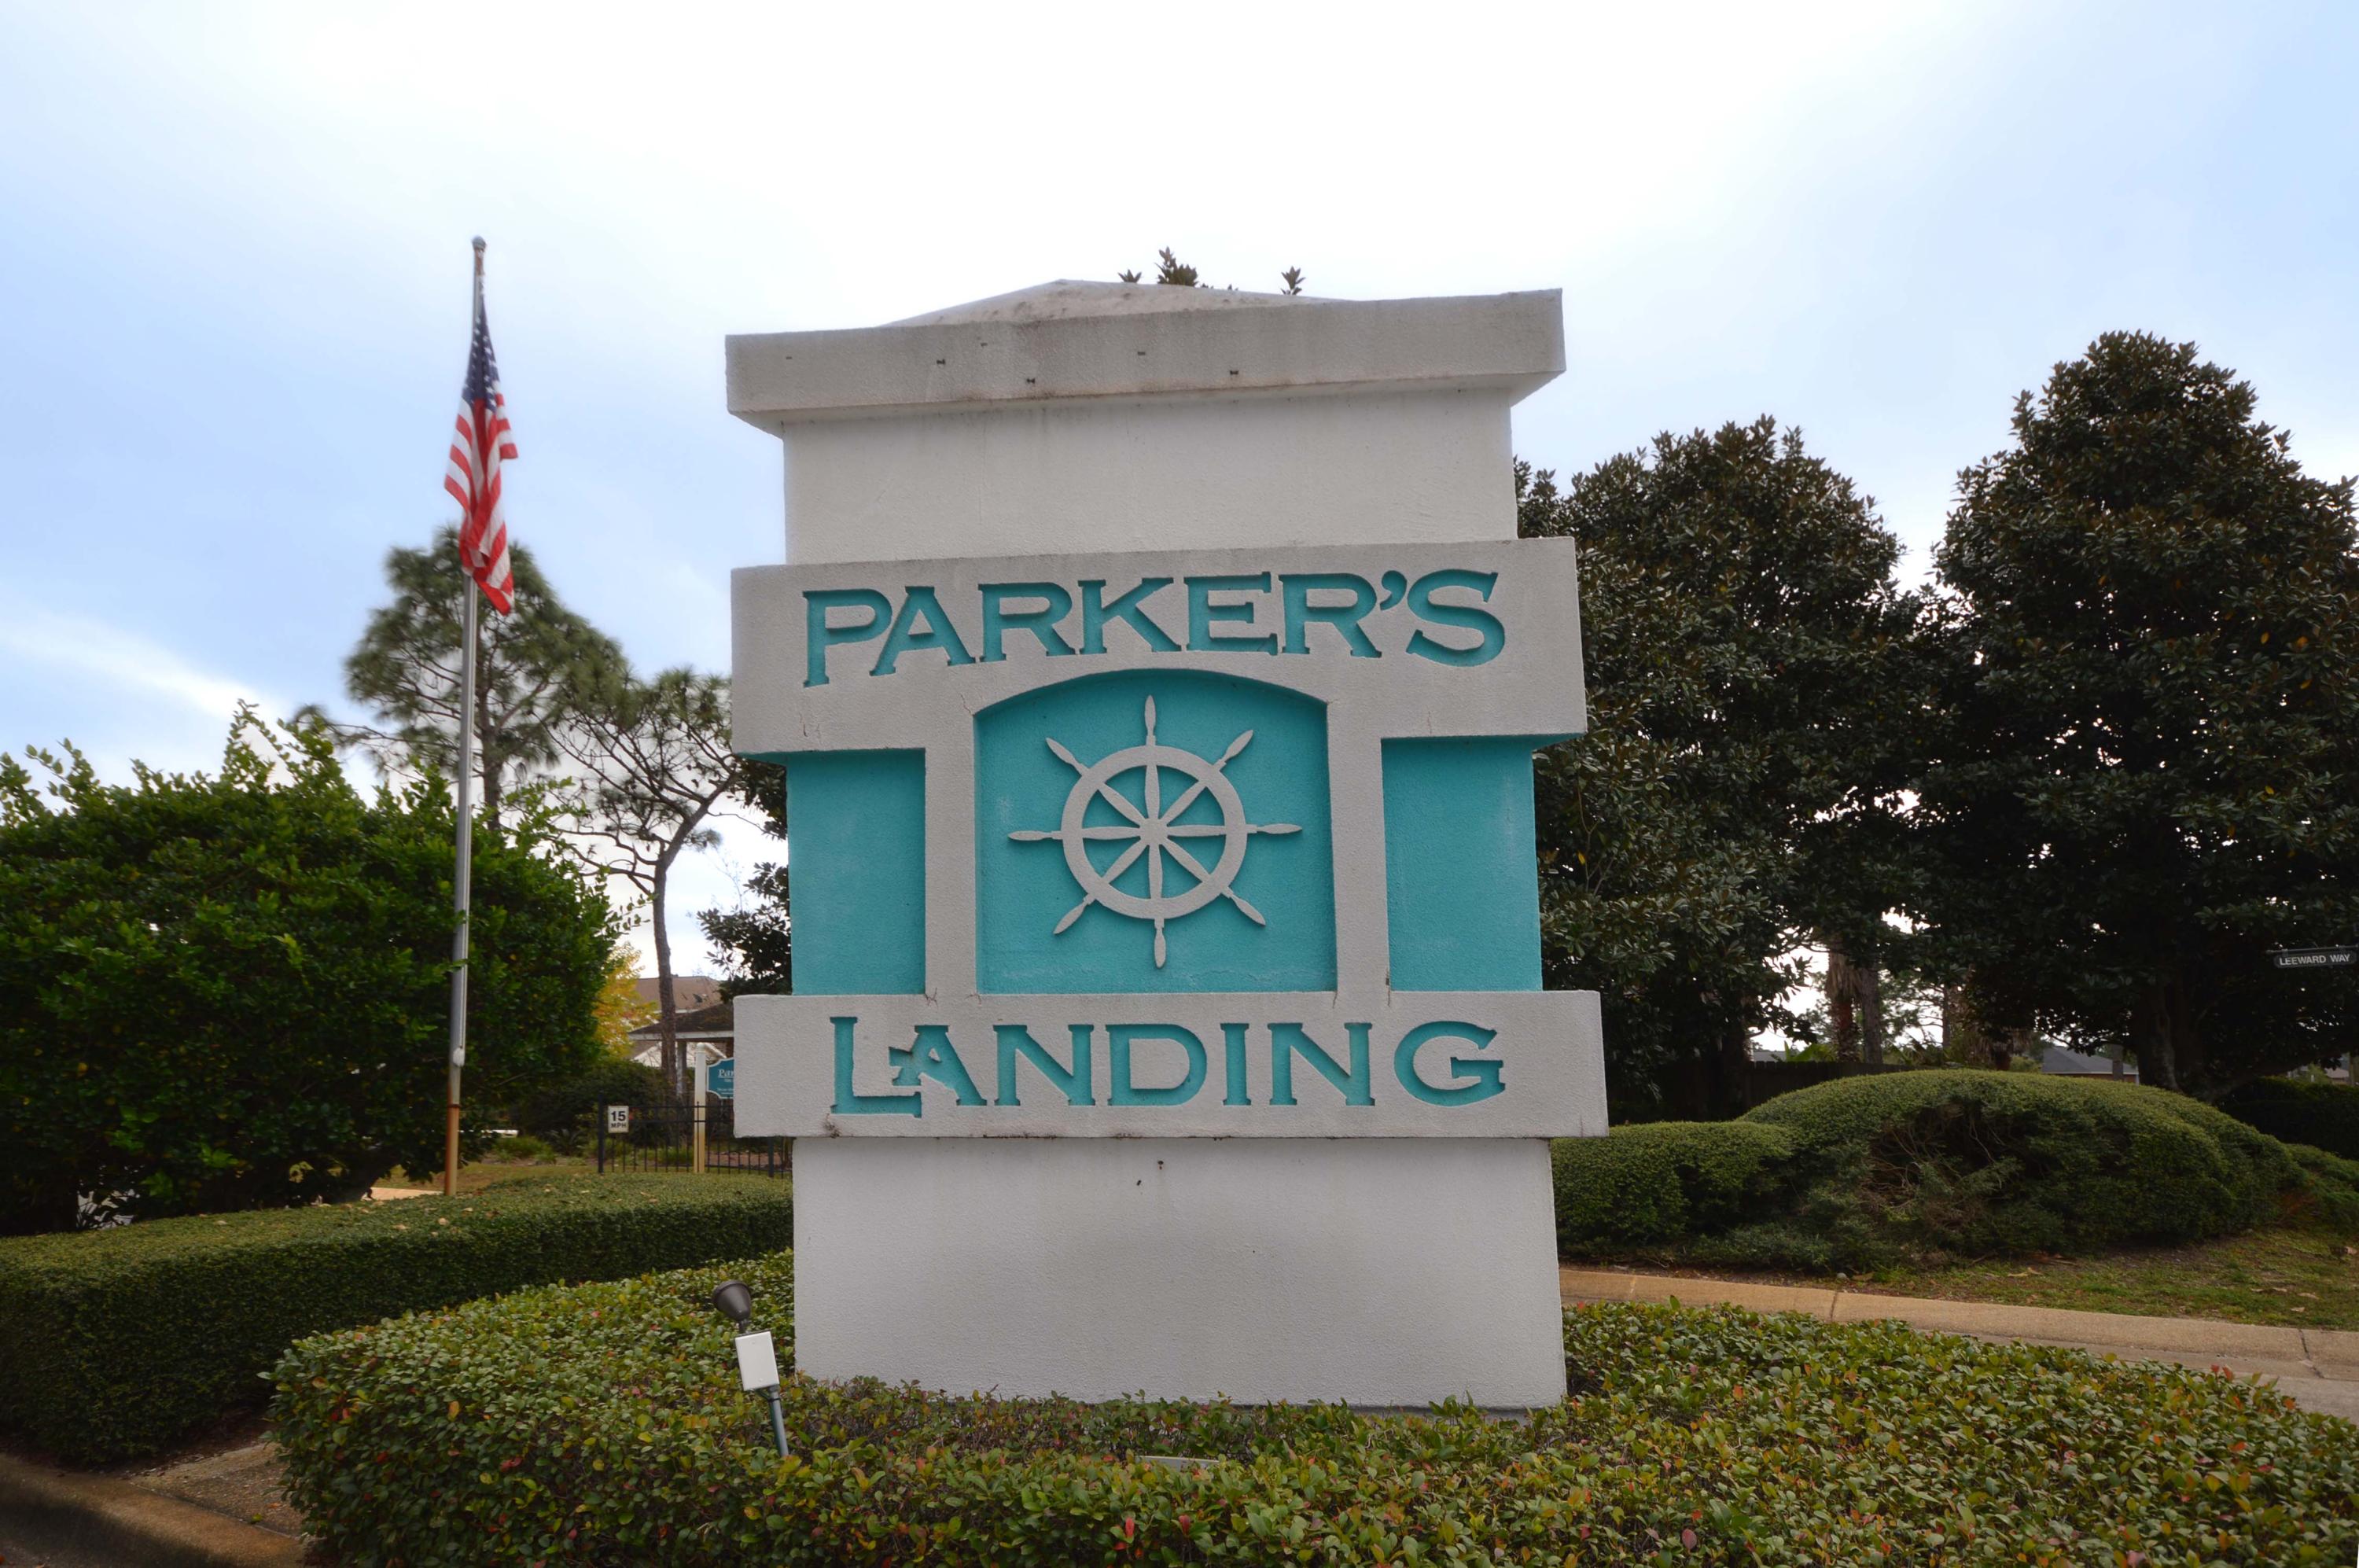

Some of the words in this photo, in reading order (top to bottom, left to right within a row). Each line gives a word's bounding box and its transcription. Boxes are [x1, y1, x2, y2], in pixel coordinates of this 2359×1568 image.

[803, 570, 1505, 687] PARKER'S
[2280, 955, 2327, 966] LEEWARD
[2330, 954, 2350, 963] WAY
[830, 1016, 1506, 1117] LANDING
[611, 1111, 626, 1121] 15
